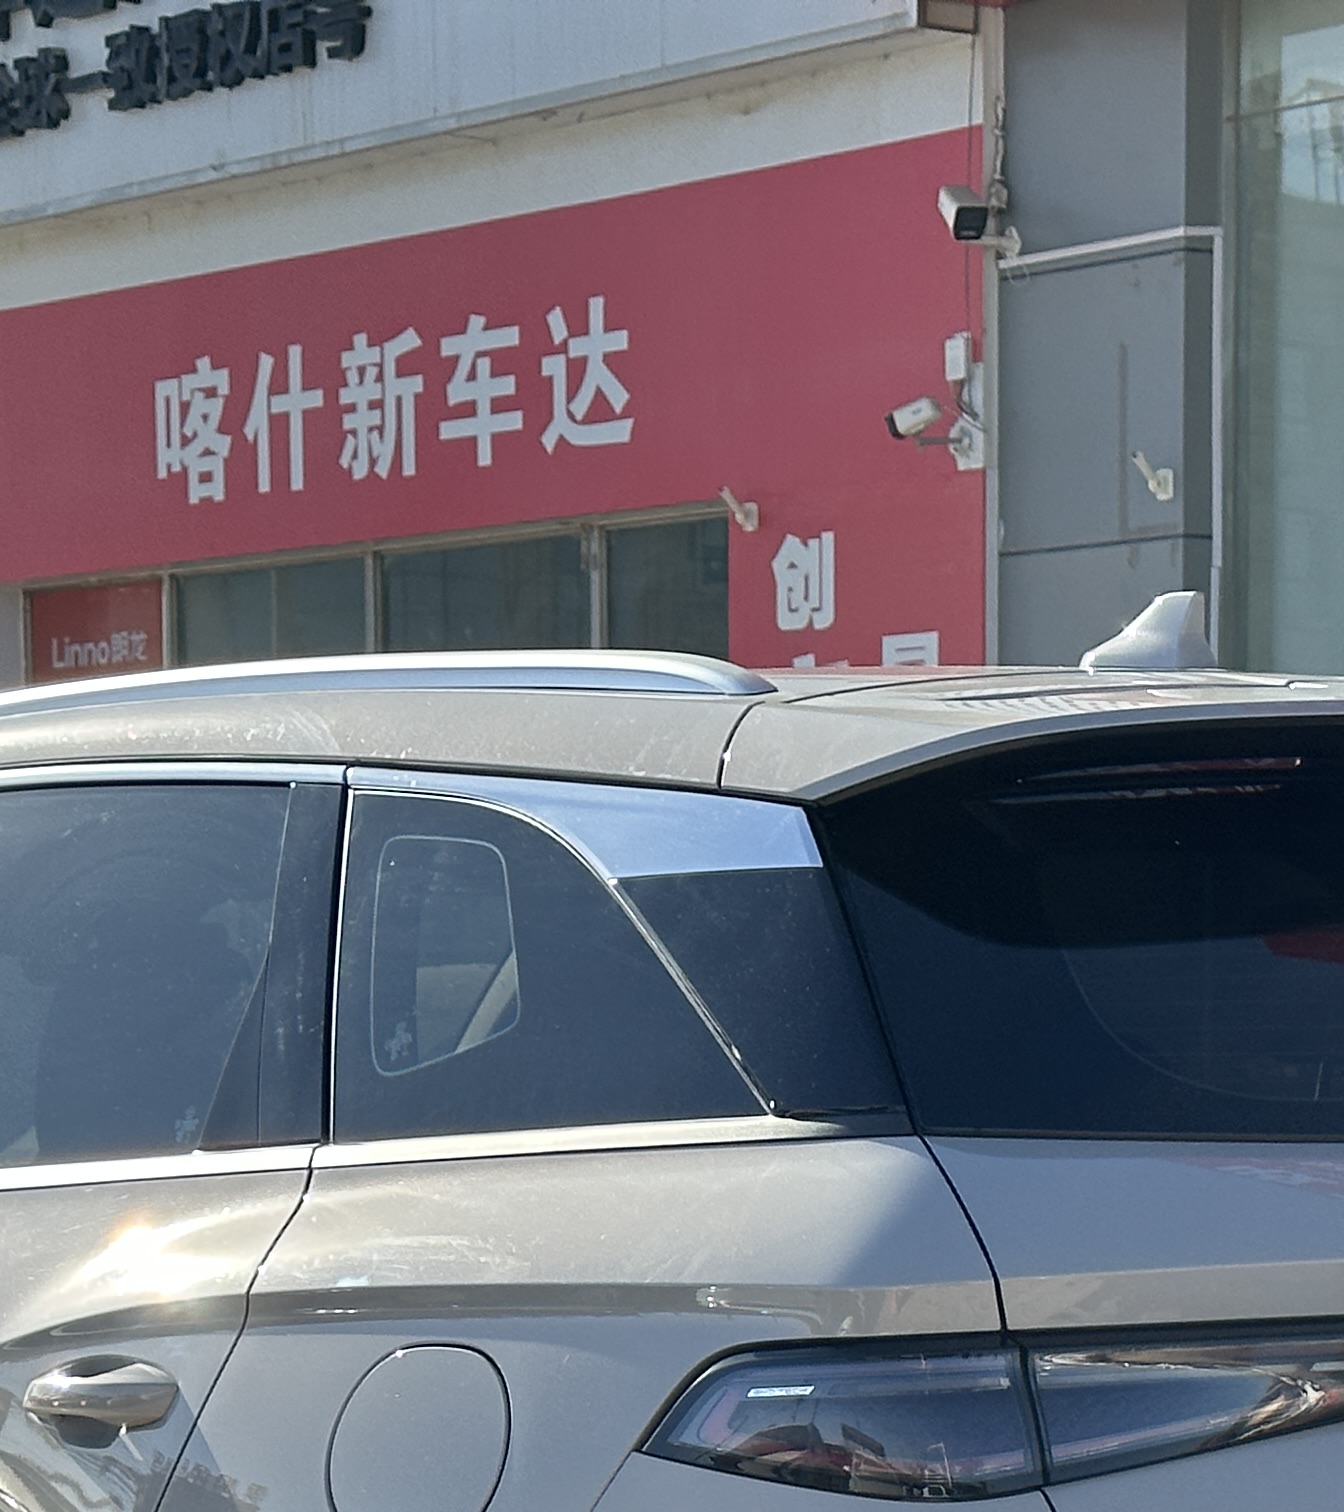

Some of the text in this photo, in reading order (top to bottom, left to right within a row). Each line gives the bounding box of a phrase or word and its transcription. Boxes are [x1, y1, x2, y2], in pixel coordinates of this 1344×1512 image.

[153, 295, 636, 505] 喀什新车达
